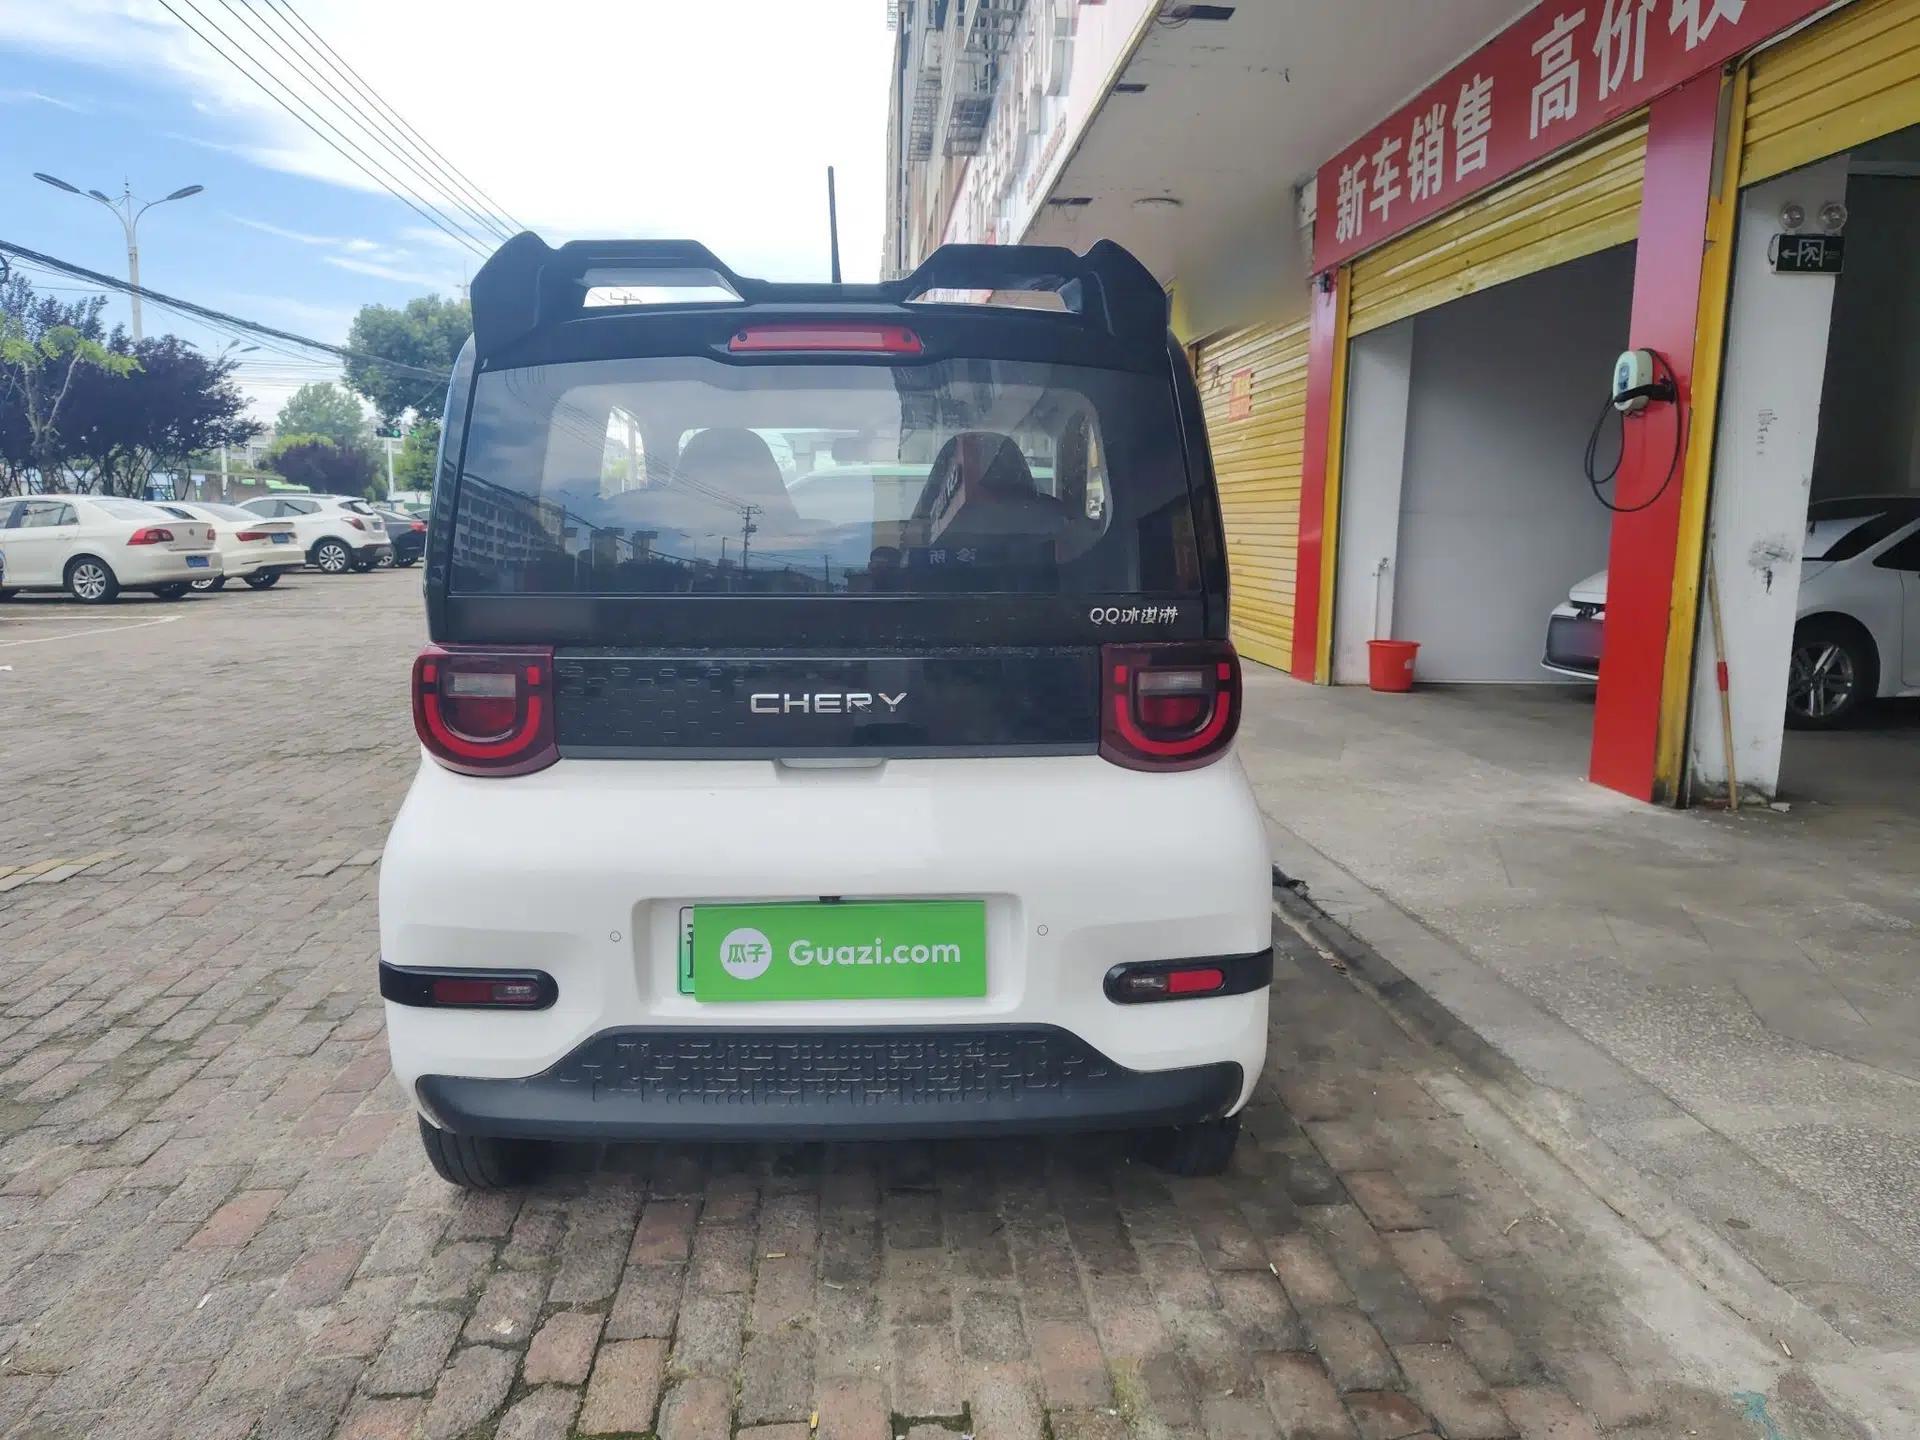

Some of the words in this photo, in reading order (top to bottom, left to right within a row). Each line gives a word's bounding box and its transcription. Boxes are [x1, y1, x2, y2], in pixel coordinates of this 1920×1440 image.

[1336, 73, 1494, 243] 新车销售
[750, 692, 908, 714] CHERY
[727, 943, 767, 964] 瓜子
[788, 937, 961, 966] Guazi.com
